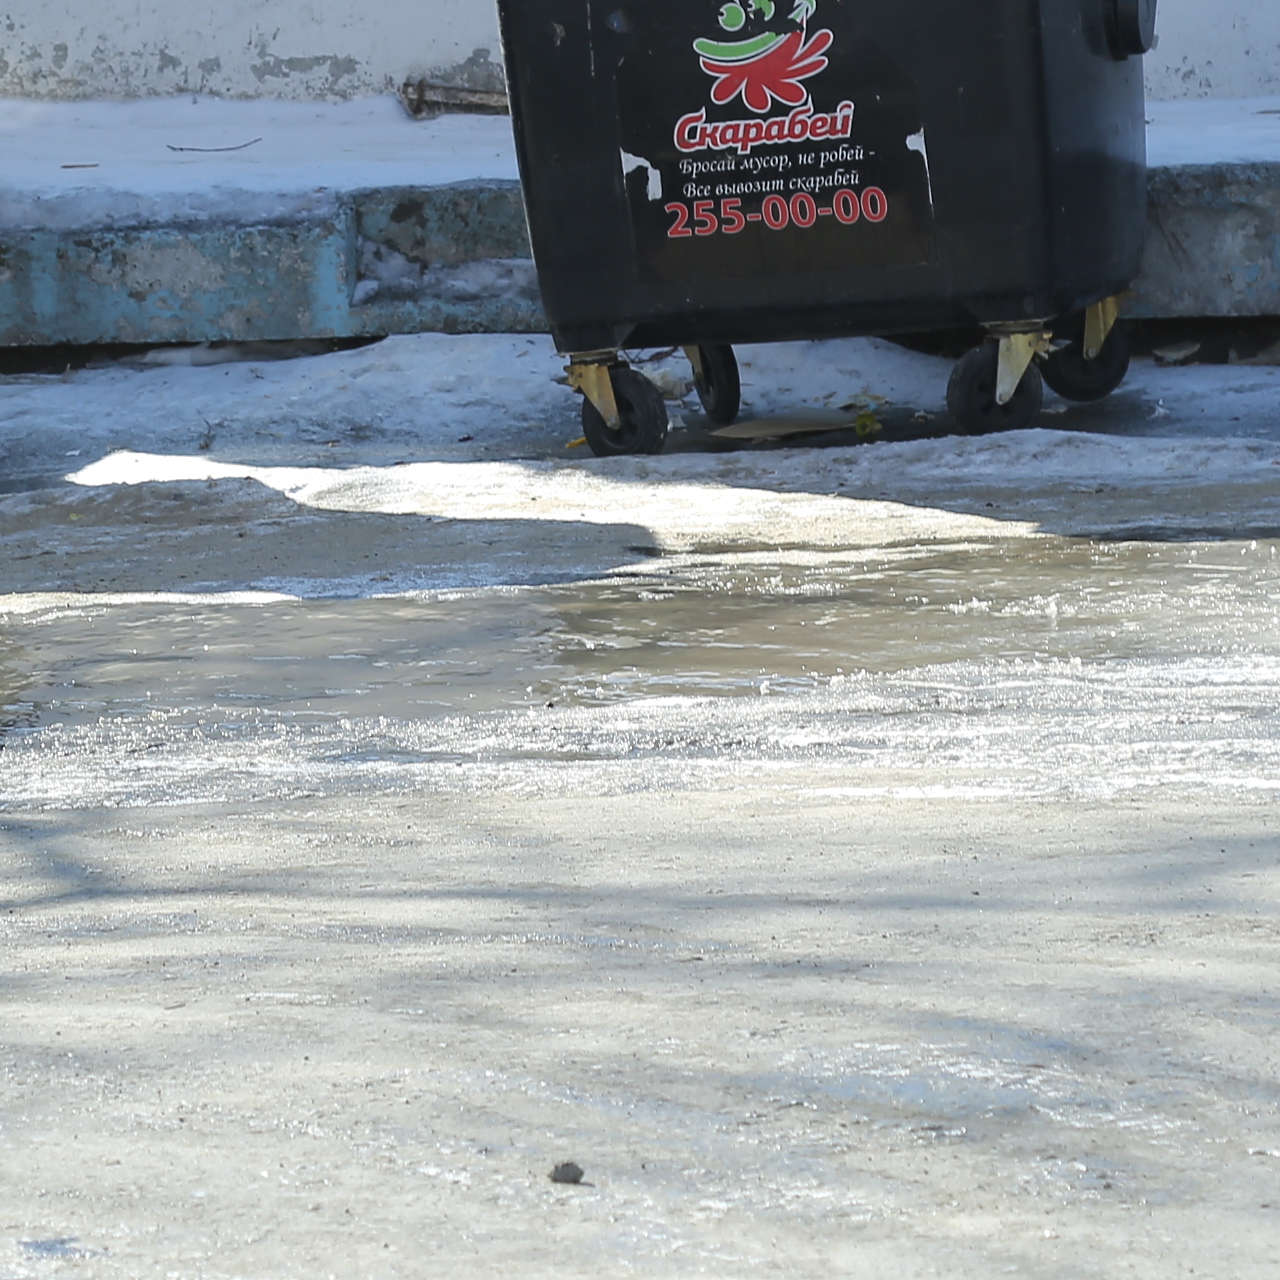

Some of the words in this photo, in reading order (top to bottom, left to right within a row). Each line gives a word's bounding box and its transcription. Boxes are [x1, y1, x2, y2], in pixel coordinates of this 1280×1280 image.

[674, 94, 855, 155] Скарабей
[679, 155, 736, 178] Бросай
[740, 156, 792, 174] мусор,
[798, 152, 815, 165] не
[821, 144, 864, 168] робей
[683, 182, 711, 198] Все
[716, 177, 784, 195] вывозит
[789, 169, 860, 192] скарабей
[664, 186, 888, 238] 255-00-00
